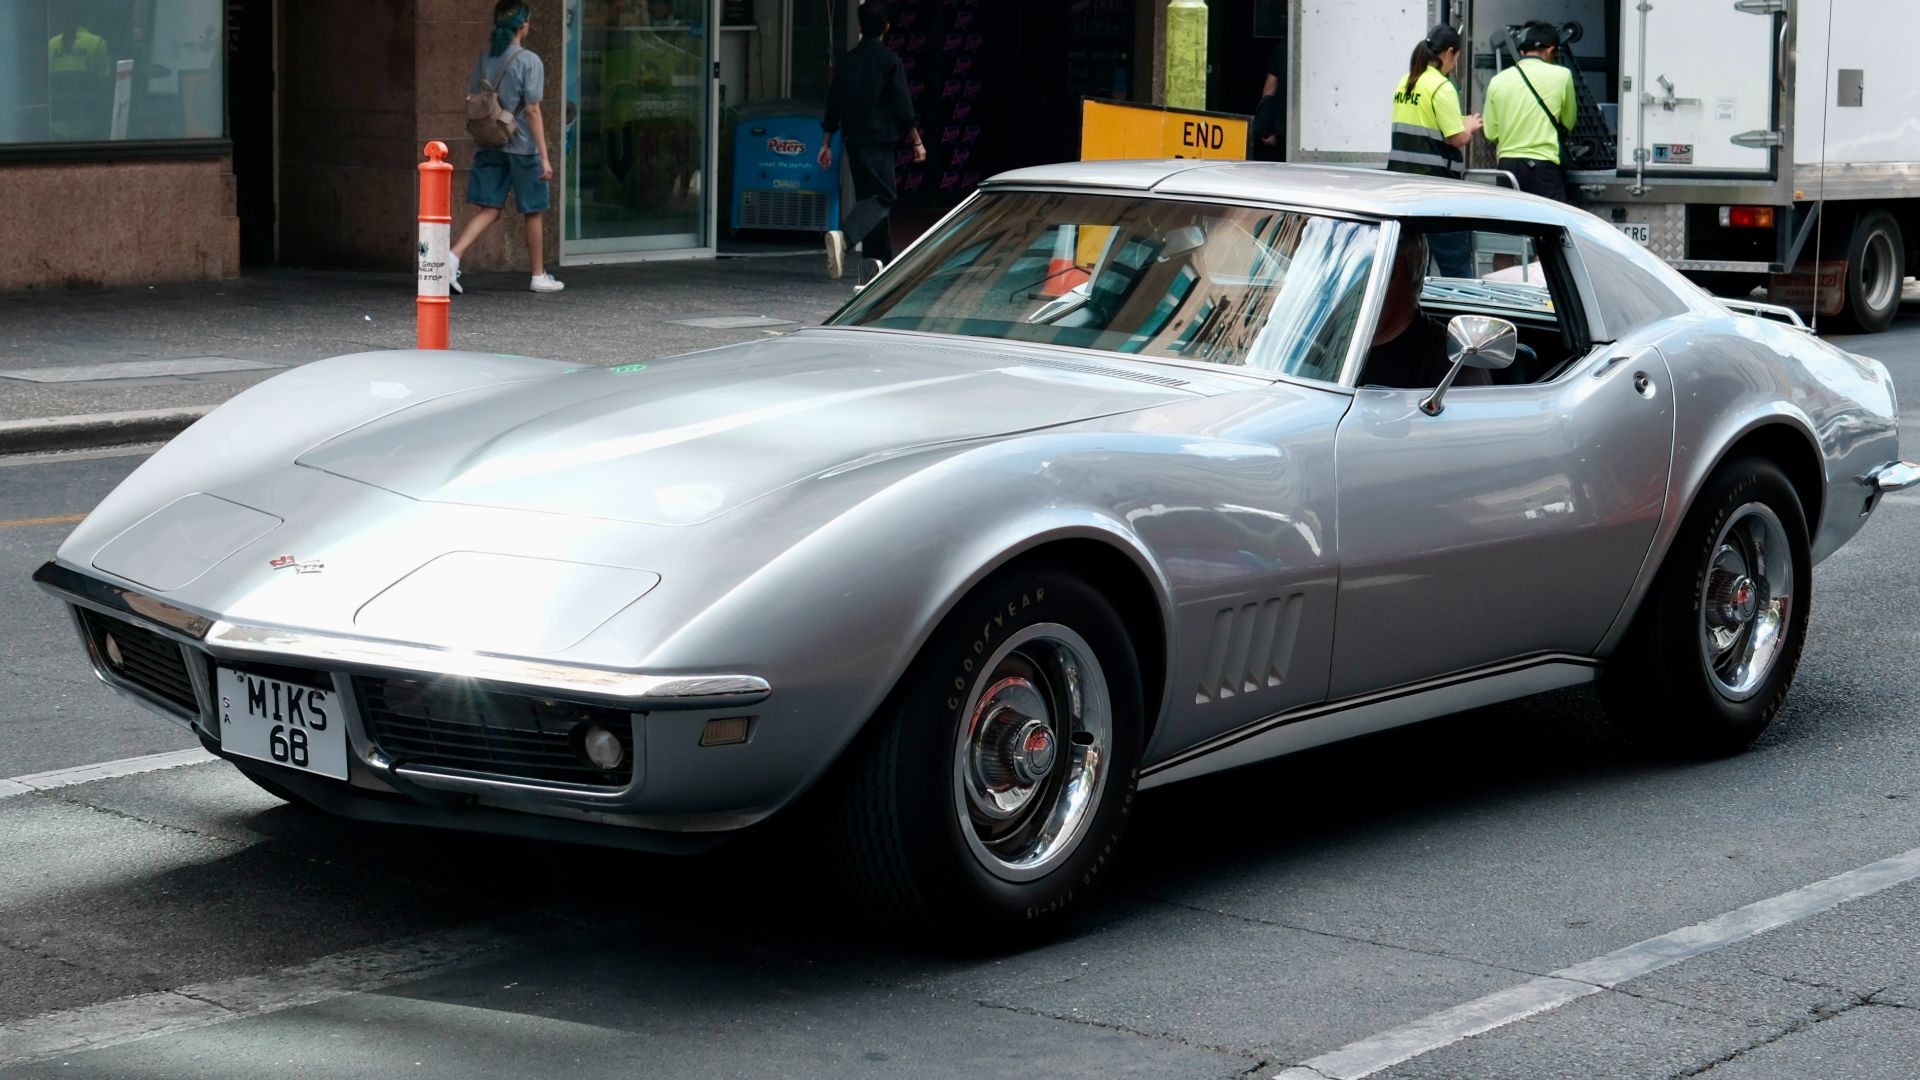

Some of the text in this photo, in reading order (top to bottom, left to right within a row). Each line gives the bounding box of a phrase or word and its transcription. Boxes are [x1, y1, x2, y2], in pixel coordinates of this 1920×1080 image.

[767, 138, 806, 154] Peters
[1183, 121, 1224, 150] END
[947, 587, 1048, 711] GOODYEAR
[247, 676, 327, 731] MIKS
[269, 724, 309, 768] 68
